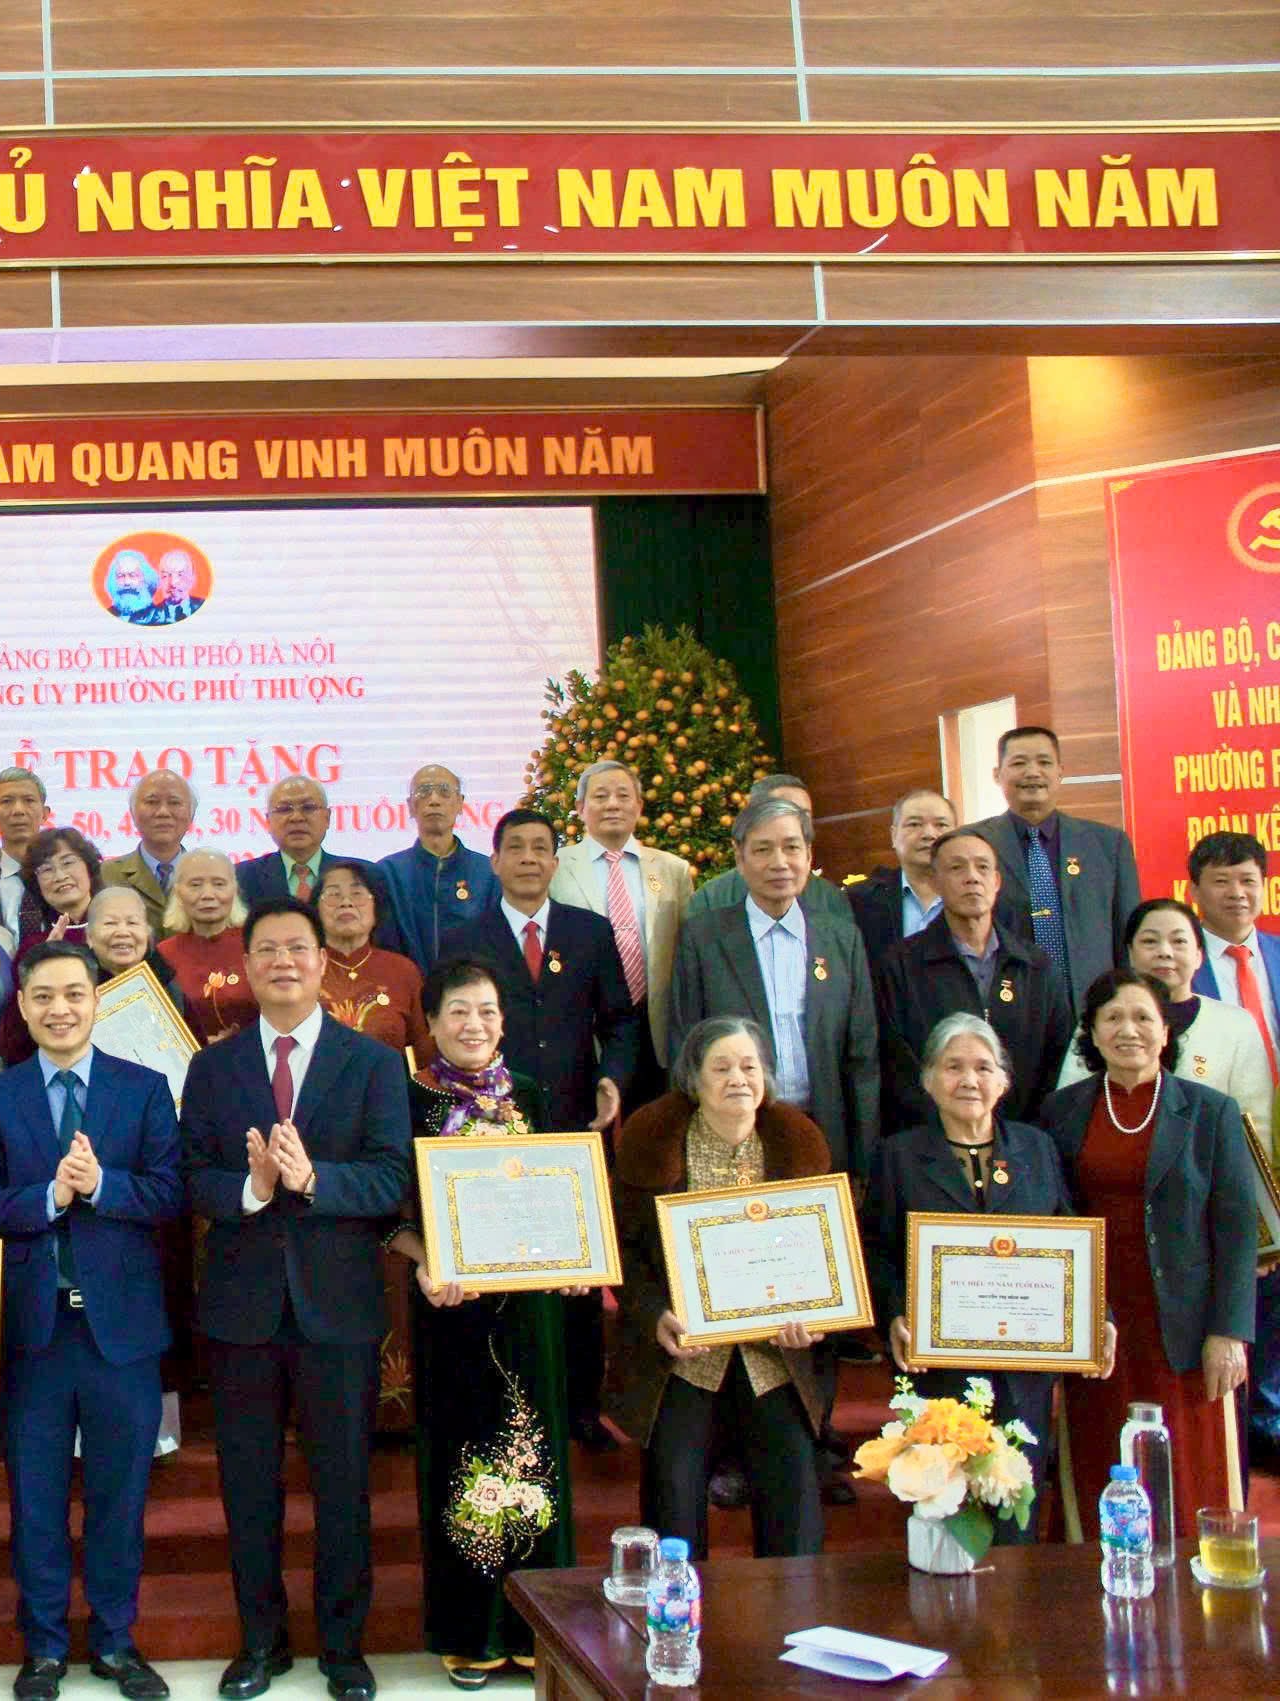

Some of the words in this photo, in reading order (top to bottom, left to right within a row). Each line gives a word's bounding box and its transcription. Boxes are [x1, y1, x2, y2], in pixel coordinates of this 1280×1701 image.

[76, 155, 333, 232] NGHĨA
[357, 151, 530, 242] VIỆT
[557, 167, 747, 228] NAM
[771, 152, 1010, 229] MUÔN
[1034, 153, 1218, 228] NĂM
[71, 441, 238, 488] QUANG
[255, 439, 367, 479] VINH
[383, 428, 528, 477] MUÔN
[543, 427, 654, 476] NĂM
[56, 641, 93, 673] BỘ
[96, 640, 186, 668] THÀNH
[193, 638, 244, 667] PHỐ
[249, 636, 285, 665] HÀ
[291, 637, 336, 668] NỘI
[1156, 620, 1217, 671] ĐẢNG
[1222, 616, 1260, 673] BỘ,
[32, 676, 68, 705] ỦY
[75, 674, 186, 705] PHƯỜNG
[194, 672, 245, 702] PHÚ
[252, 673, 365, 705] THƯỢNG
[1211, 681, 1244, 728] VÀ
[54, 747, 194, 790] TRAO
[204, 738, 342, 797] TẶNG
[1173, 742, 1266, 794] PHƯỜNG
[209, 807, 241, 835] 30
